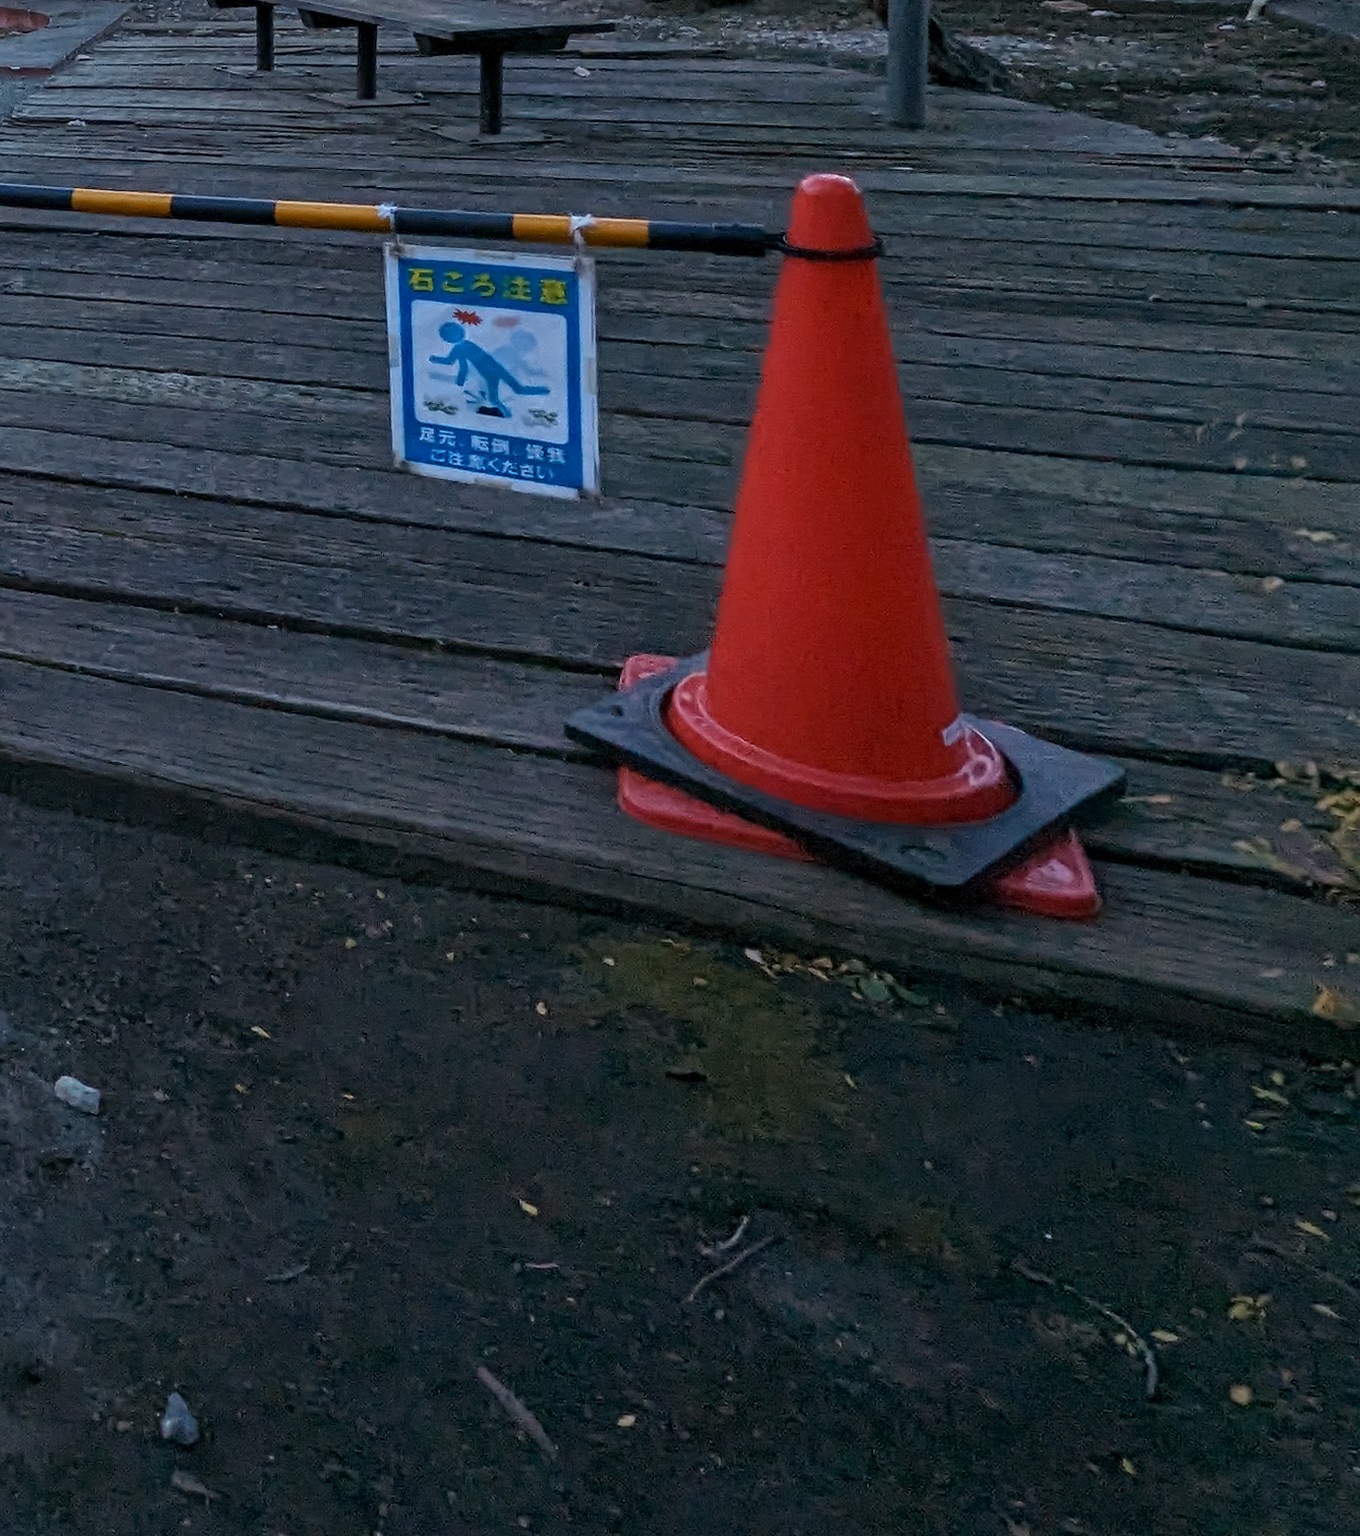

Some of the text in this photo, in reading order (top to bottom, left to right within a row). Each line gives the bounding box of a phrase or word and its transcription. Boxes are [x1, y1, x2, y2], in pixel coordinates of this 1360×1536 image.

[408, 267, 568, 305] 石ころ注意
[430, 448, 555, 480] ご注意ください
